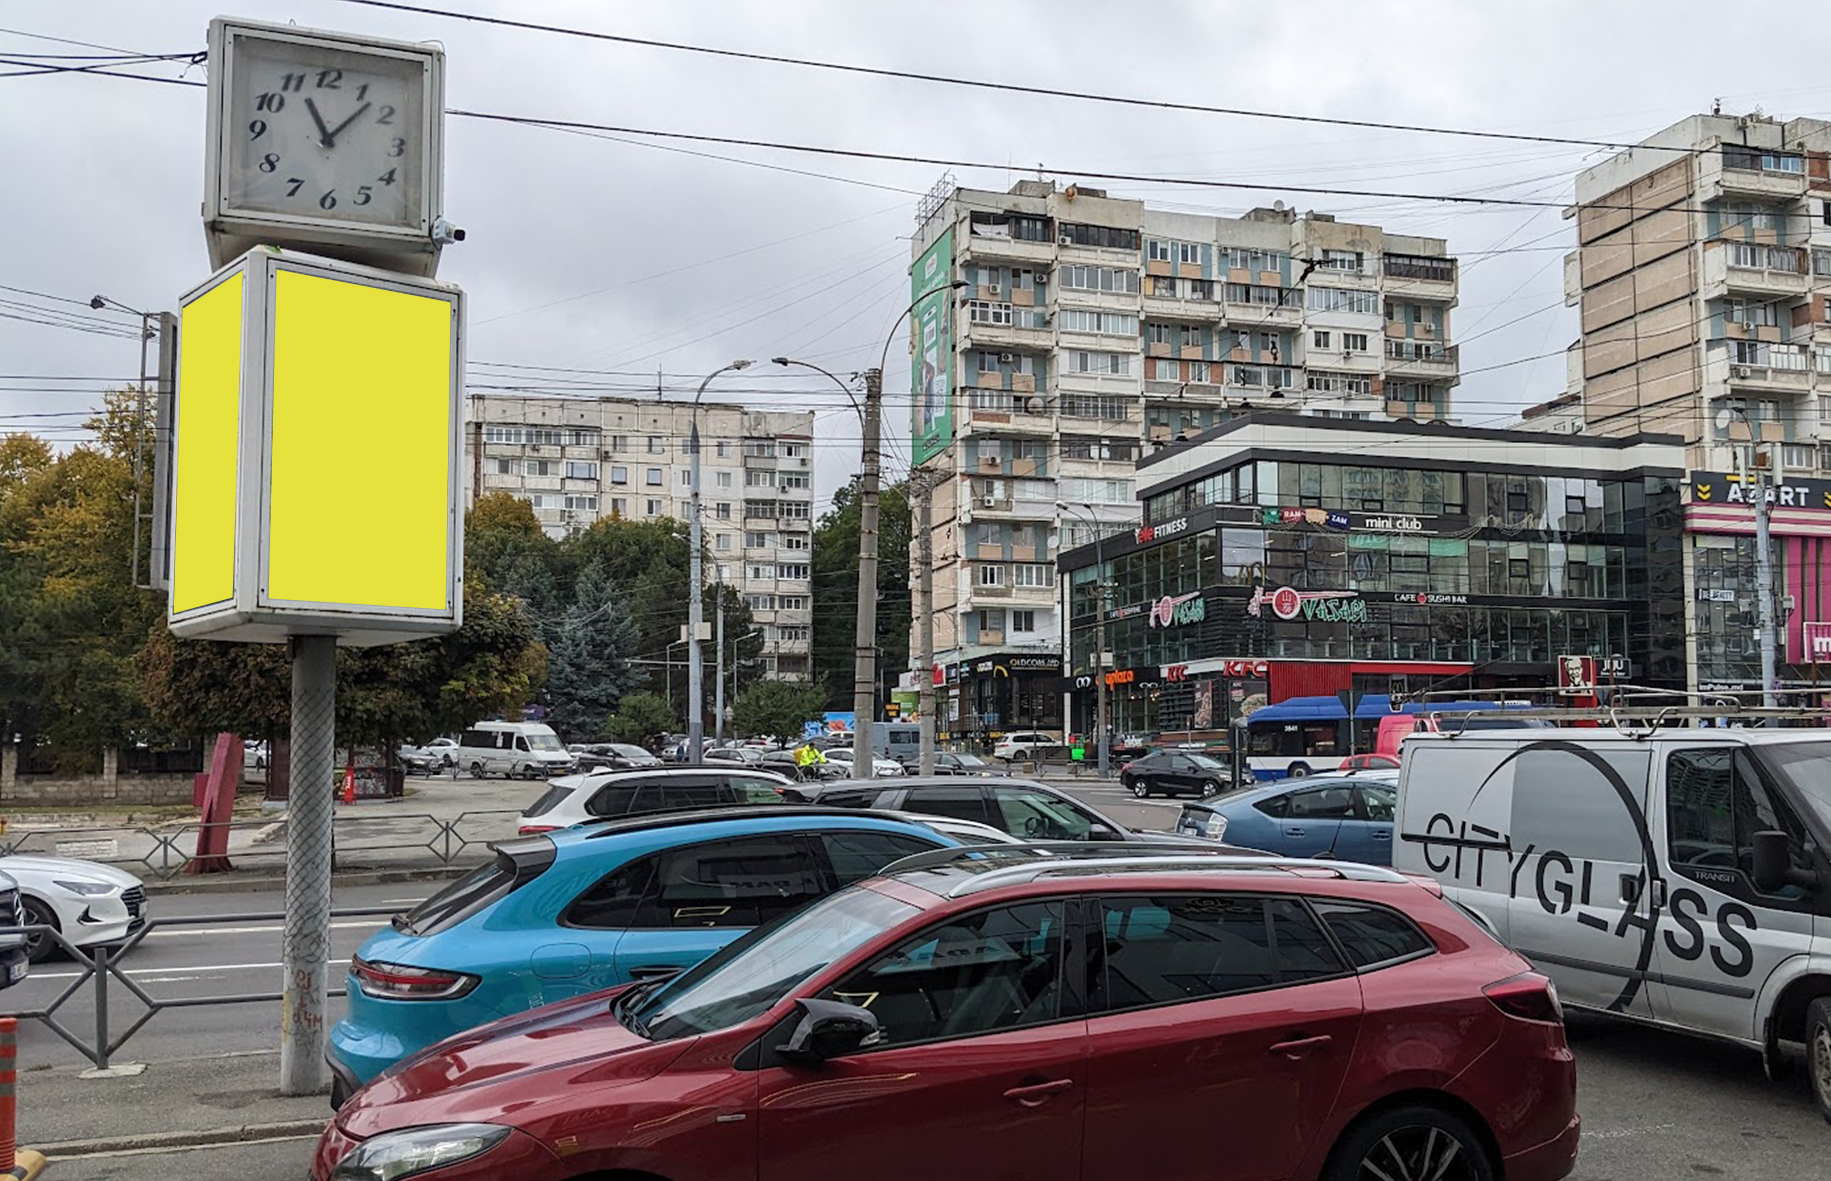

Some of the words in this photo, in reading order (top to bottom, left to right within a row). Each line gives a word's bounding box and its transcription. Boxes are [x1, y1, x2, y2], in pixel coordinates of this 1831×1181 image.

[281, 73, 307, 92] 11
[315, 69, 343, 89] 12
[356, 83, 369, 101] 1
[255, 93, 285, 113] 10
[375, 105, 395, 124] 2
[249, 119, 267, 141] 9
[387, 137, 405, 158] 3
[259, 153, 280, 173] 8
[377, 167, 397, 186] 4
[286, 178, 305, 197] 7
[353, 185, 372, 206] 5
[319, 189, 337, 210] 6
[1154, 517, 1187, 539] FITNESS
[1365, 517, 1392, 529] mini
[1396, 517, 1422, 530] club
[1394, 594, 1416, 602] CAFE
[1427, 595, 1451, 603] SUSHI
[1452, 596, 1467, 604] BAR
[1167, 664, 1188, 682] KFC
[1223, 661, 1268, 678] KFC
[1694, 871, 1736, 883] TRANSIT
[1423, 812, 1758, 978] CITYGLASS
